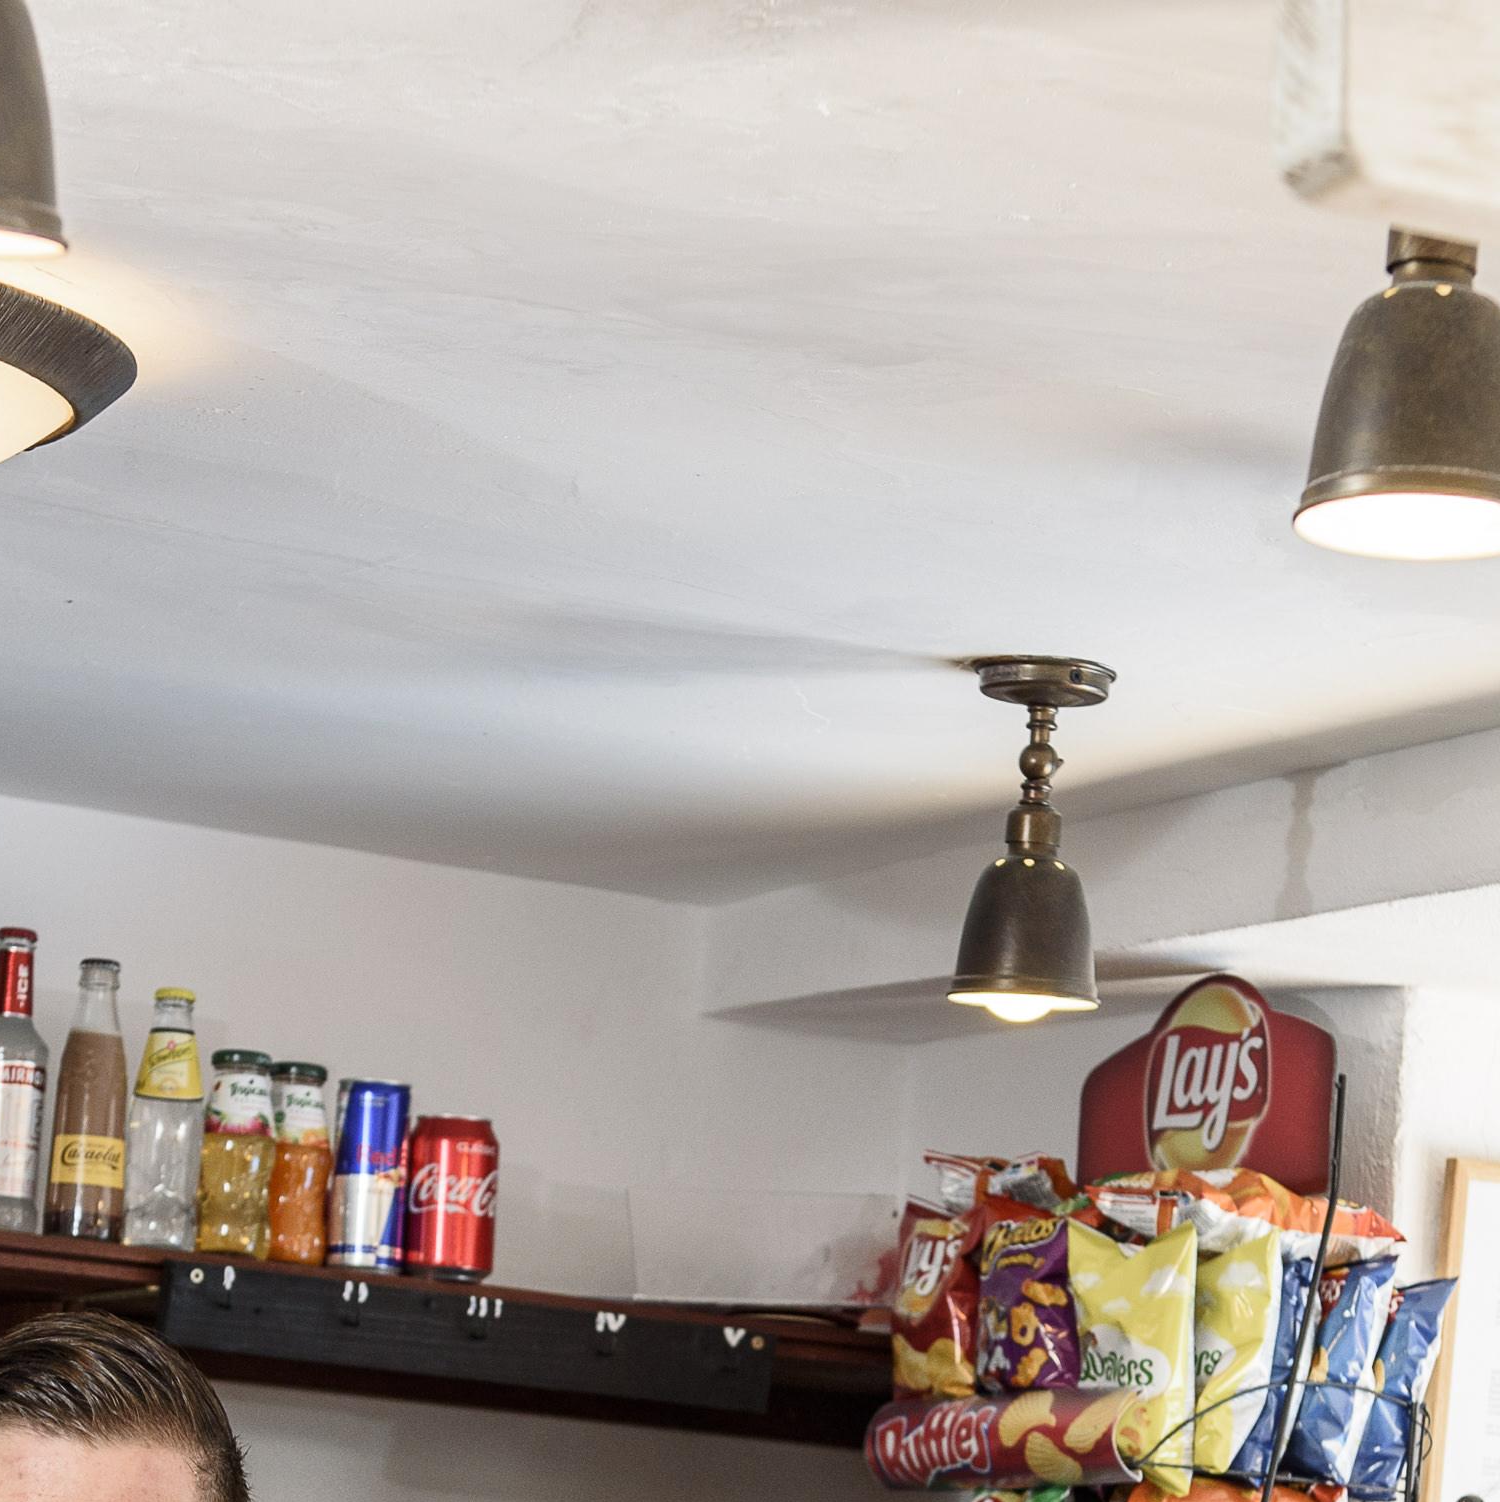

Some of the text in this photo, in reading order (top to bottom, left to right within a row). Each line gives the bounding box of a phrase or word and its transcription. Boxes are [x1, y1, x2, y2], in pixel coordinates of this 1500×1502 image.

[1153, 1030, 1262, 1150] Lay's
[596, 1312, 625, 1333] IV
[723, 1327, 745, 1347] V
[877, 1403, 997, 1480] Ruffles
